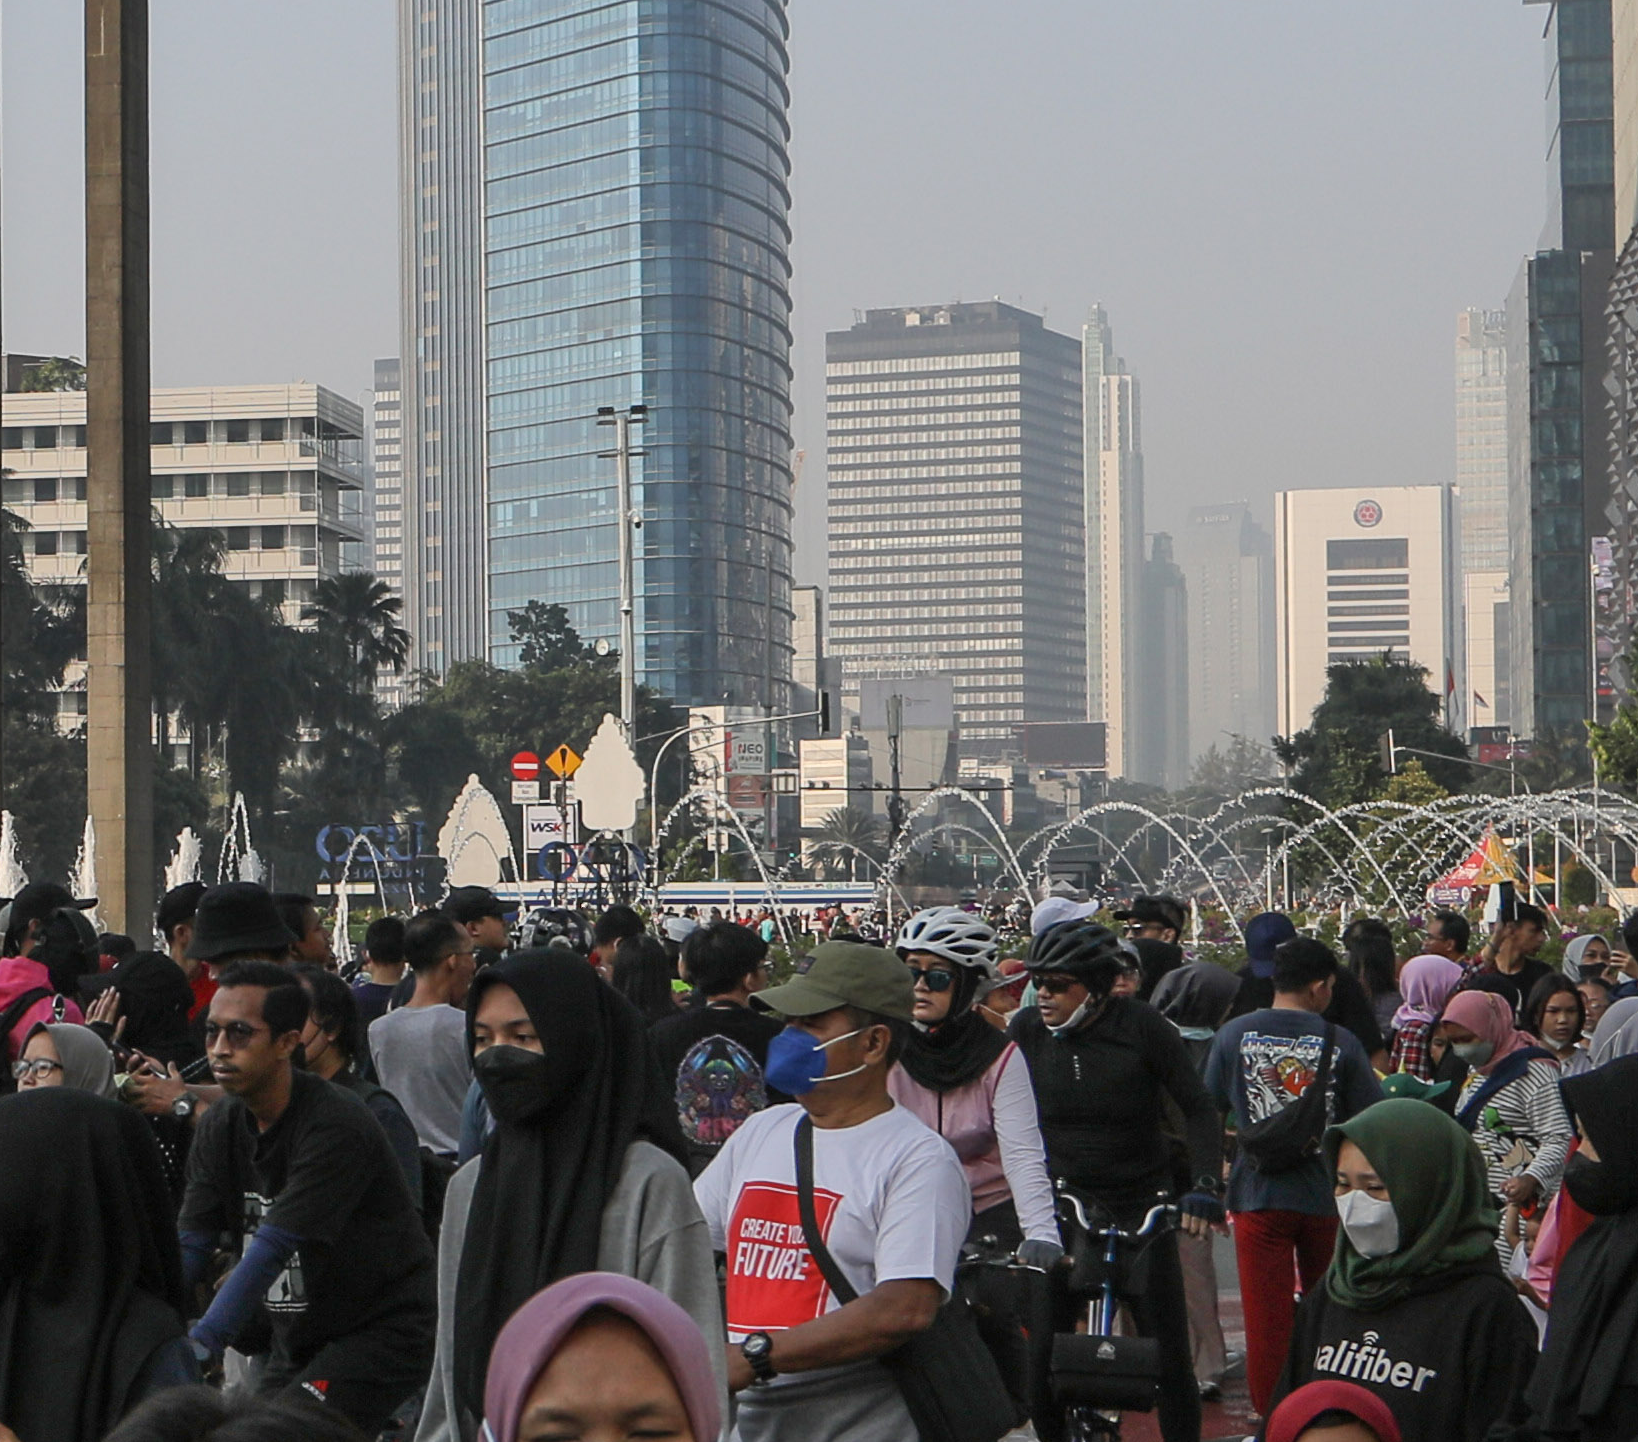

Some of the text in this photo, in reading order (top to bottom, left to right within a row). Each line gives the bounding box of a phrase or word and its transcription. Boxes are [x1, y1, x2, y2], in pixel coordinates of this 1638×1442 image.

[738, 743, 764, 755] NEO
[740, 1217, 787, 1243] CREATE
[733, 1241, 812, 1281] FUTURE
